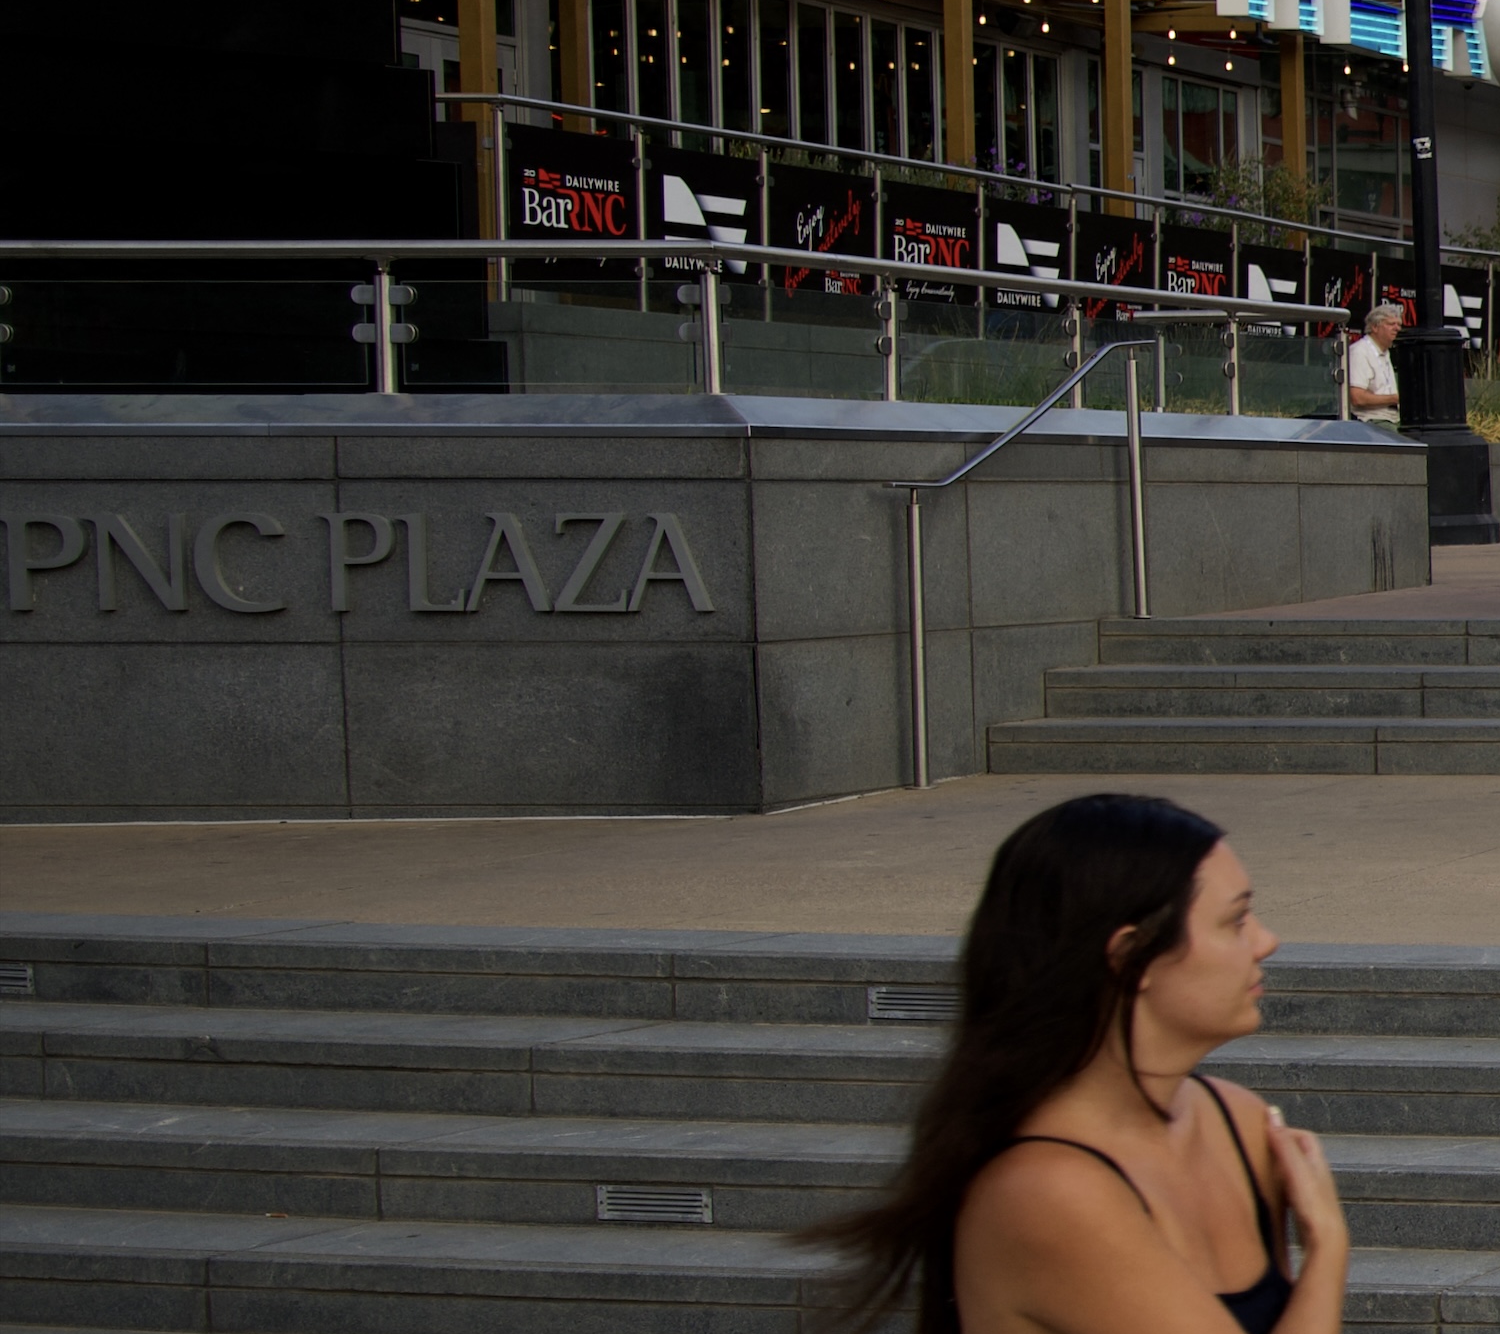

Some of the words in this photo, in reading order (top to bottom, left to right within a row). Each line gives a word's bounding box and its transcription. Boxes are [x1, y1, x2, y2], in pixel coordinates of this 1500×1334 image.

[565, 174, 620, 193] DAILYWIRE
[925, 222, 966, 238] DAILYWIRE
[1191, 260, 1224, 274] DAILYWIRE
[997, 292, 1041, 307] DAILYWIRE
[2, 511, 289, 614] PNC
[318, 512, 716, 614] PLAZA
